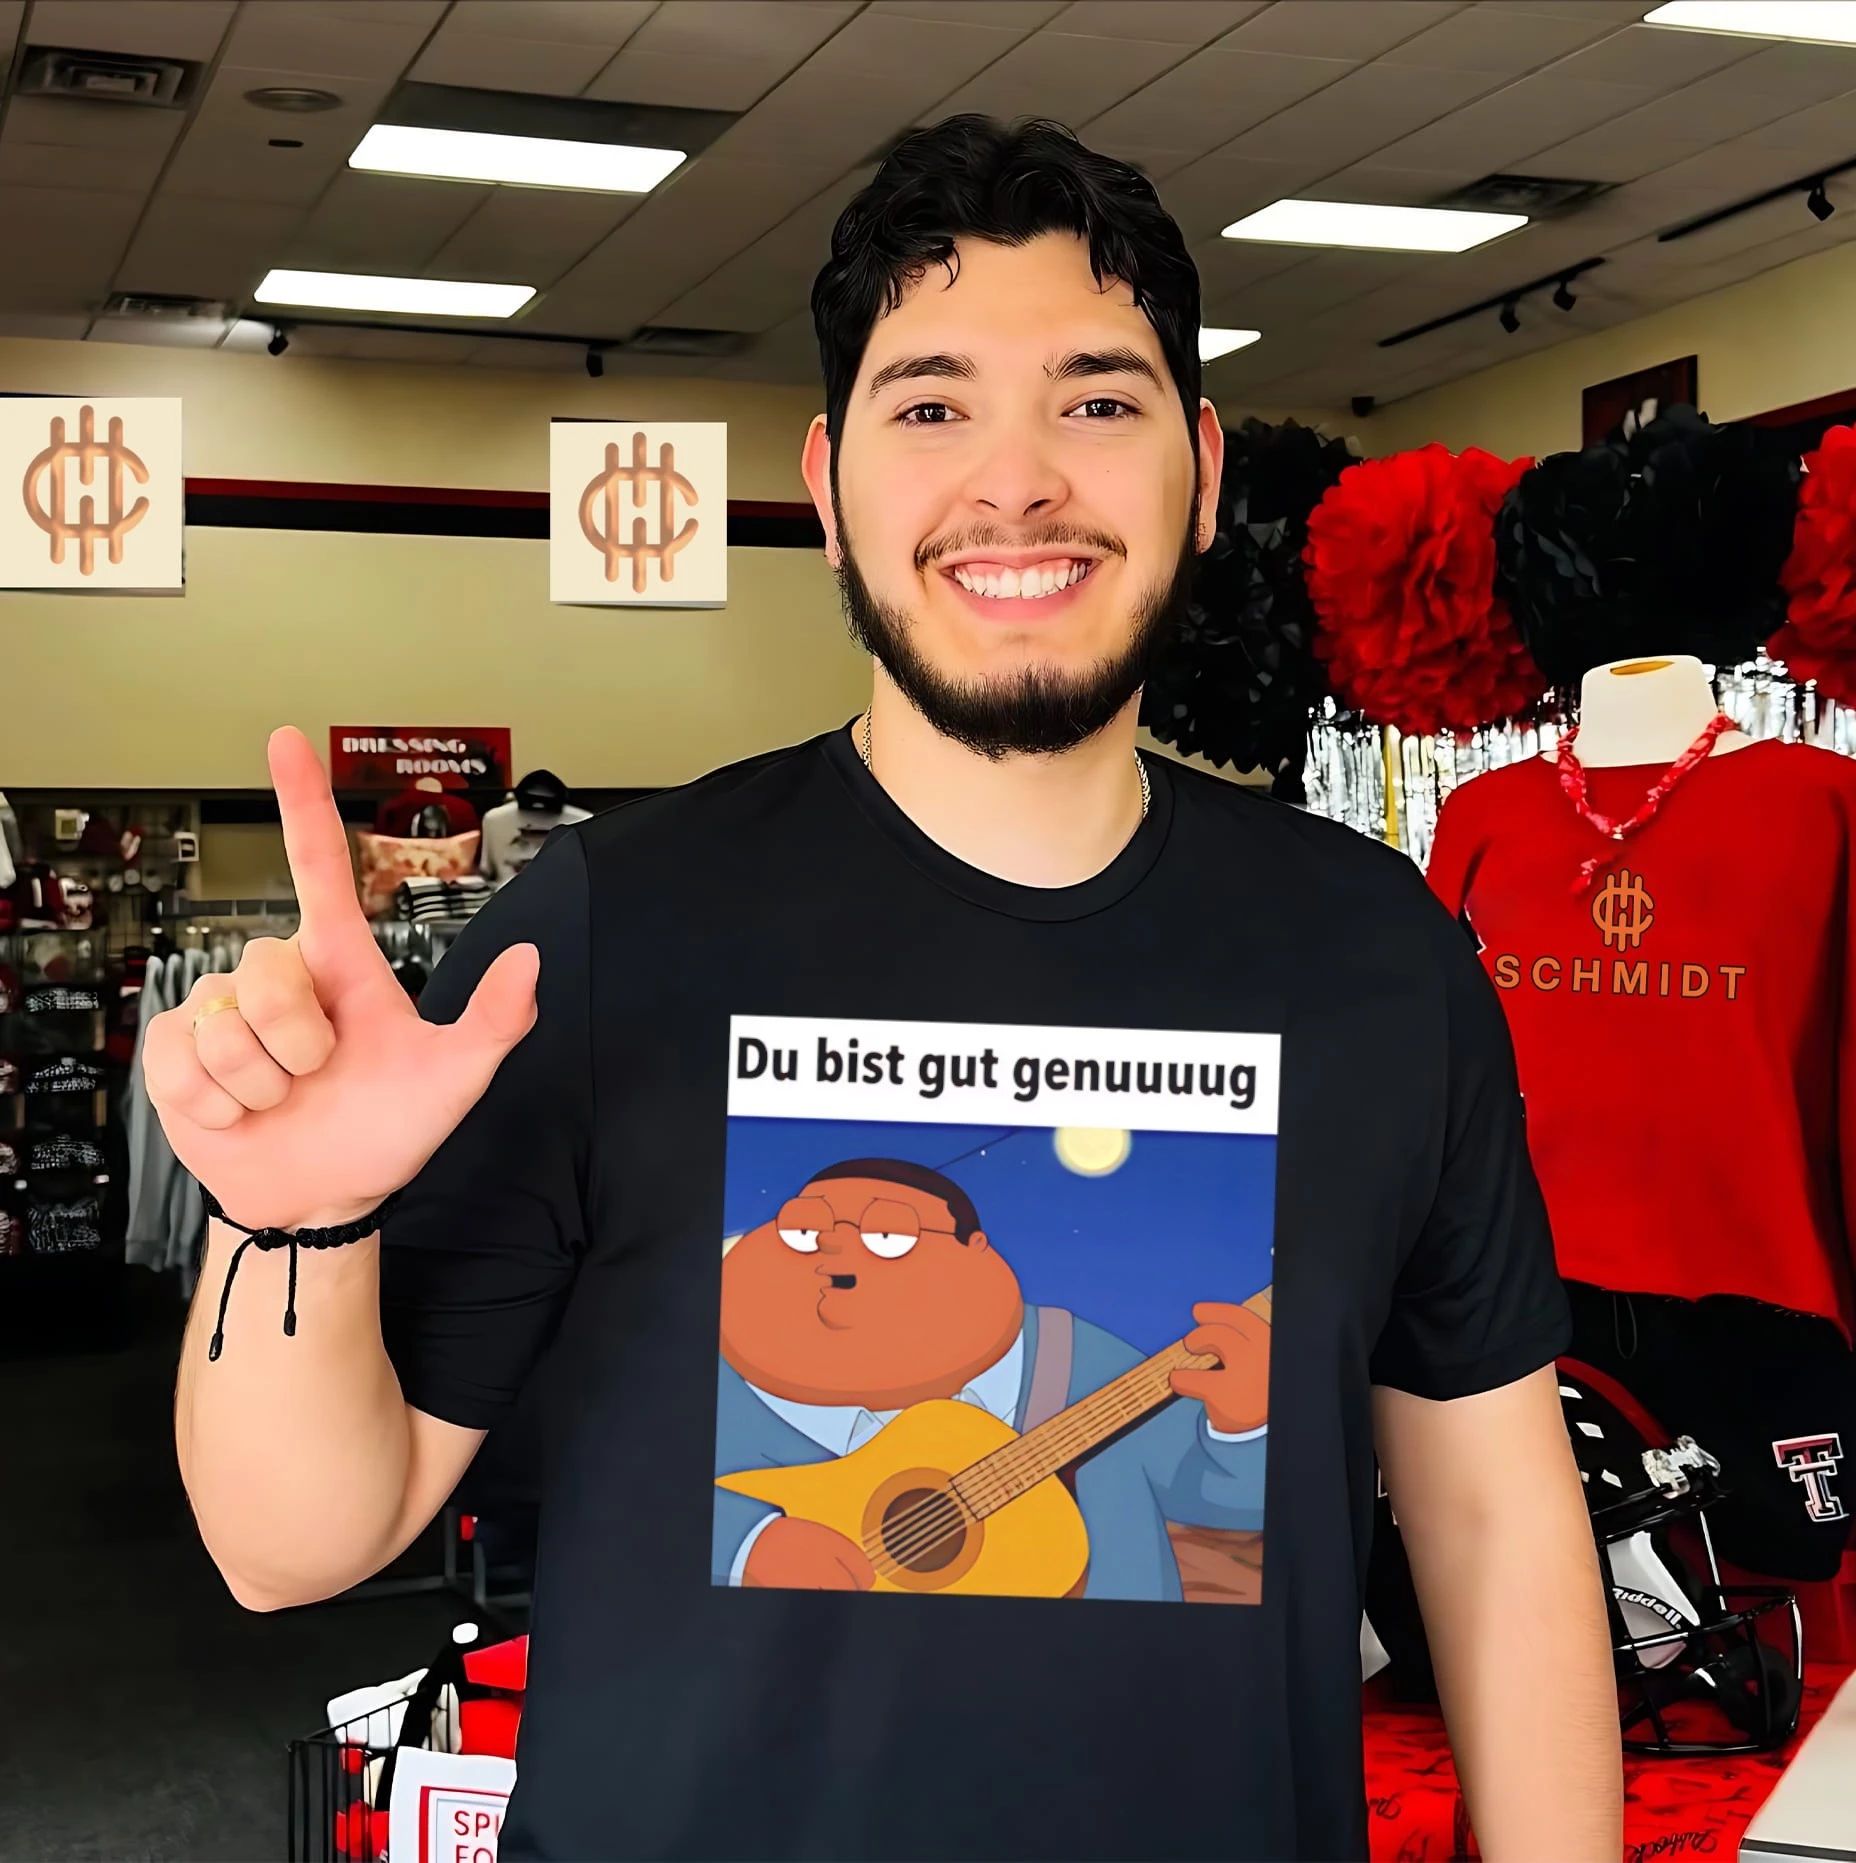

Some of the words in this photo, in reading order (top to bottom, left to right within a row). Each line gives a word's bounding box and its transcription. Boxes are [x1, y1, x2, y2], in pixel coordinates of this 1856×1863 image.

[1494, 954, 1746, 999] SCHMIDT
[736, 1036, 798, 1081] Du
[815, 1037, 904, 1085] bist
[918, 1048, 999, 1099] gut
[1012, 1055, 1257, 1110] genuuuug
[454, 1810, 500, 1838] SPI
[455, 1844, 494, 1863] FO
